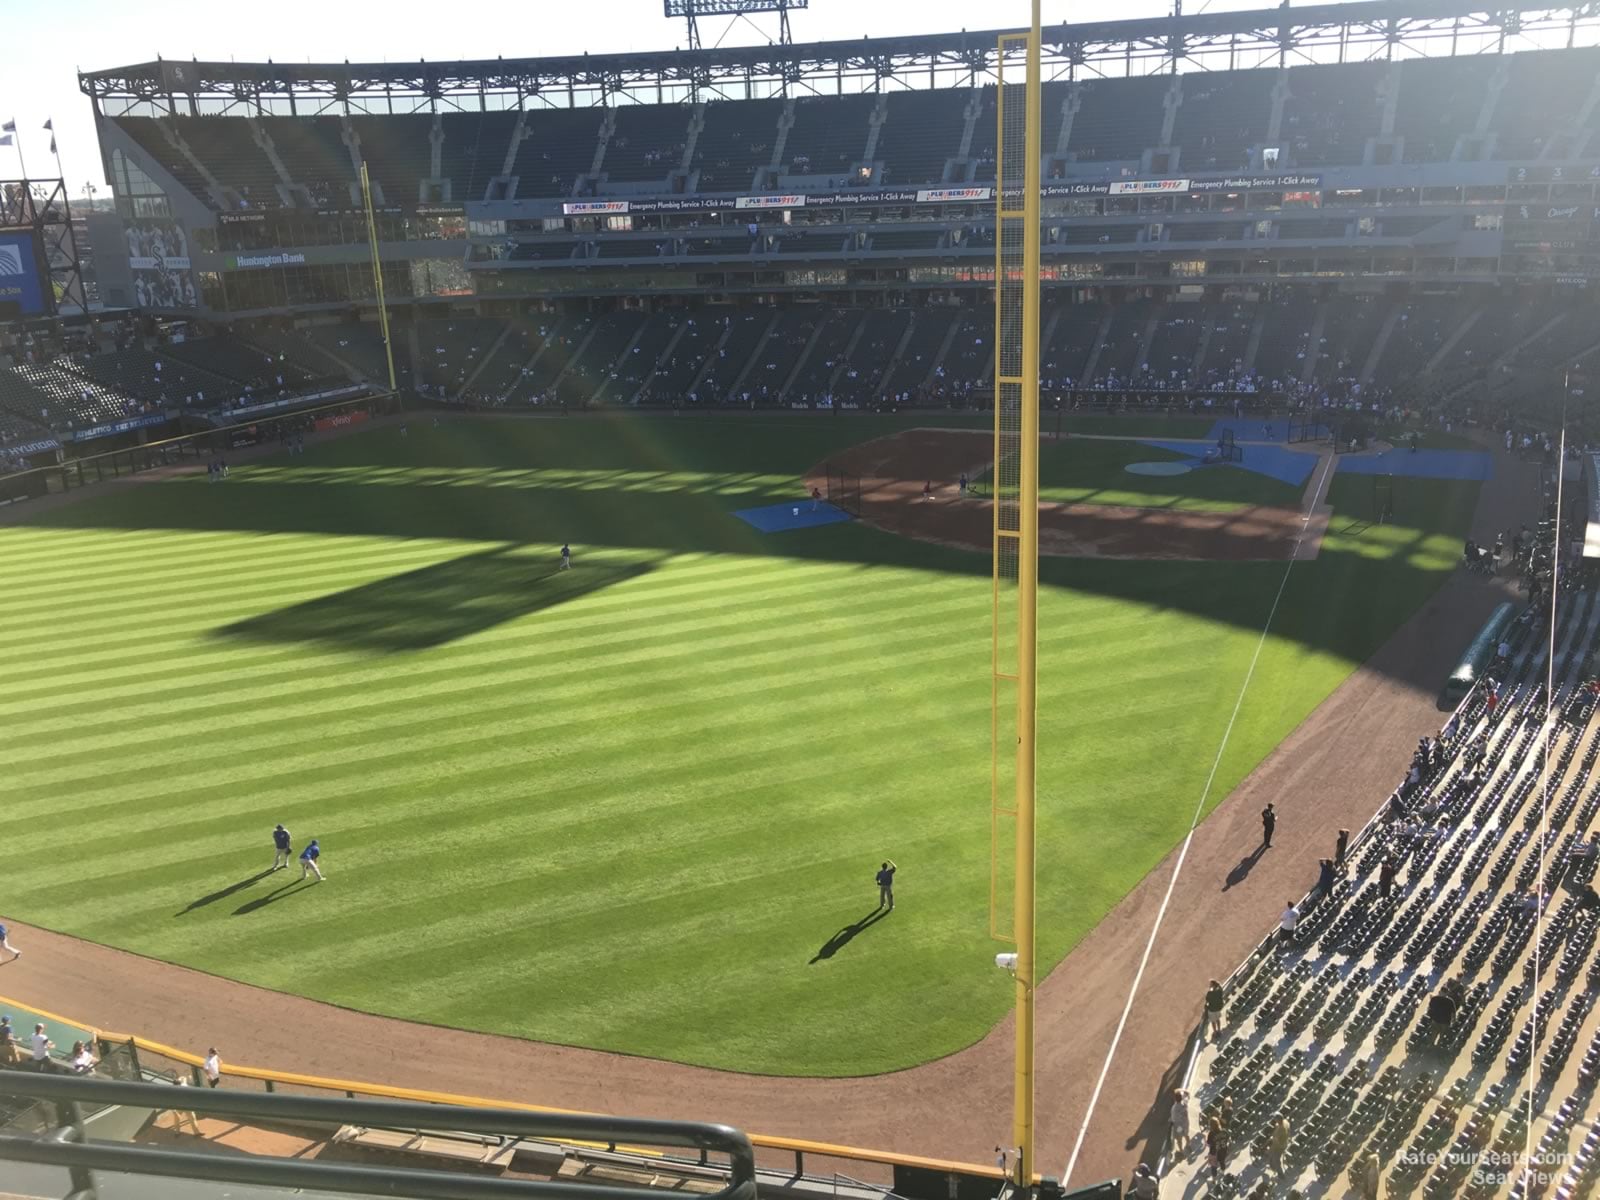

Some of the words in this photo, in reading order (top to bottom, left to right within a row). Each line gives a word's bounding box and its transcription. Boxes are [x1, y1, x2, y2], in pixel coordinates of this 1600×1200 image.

[1048, 186, 1069, 194] Service
[1070, 186, 1090, 194] 1-Click
[1090, 186, 1108, 194] Away
[1190, 180, 1223, 190] Emergency
[1224, 179, 1252, 189] Plumbing
[1252, 178, 1276, 186] Service
[1277, 177, 1299, 185] 1-Click
[1301, 176, 1320, 185] Away
[630, 202, 656, 211] Emergency
[657, 201, 681, 210] Plumbing
[681, 200, 700, 208] Service
[719, 200, 735, 208] Away
[806, 195, 834, 204] Emergency
[835, 194, 858, 203] Plumbing
[880, 193, 899, 201] 1-Click
[899, 193, 916, 201] Away
[237, 253, 282, 267] Huntington
[283, 252, 305, 264] Bank
[76, 425, 112, 439] ATHLETICO
[8, 439, 59, 455] HYUNDAI
